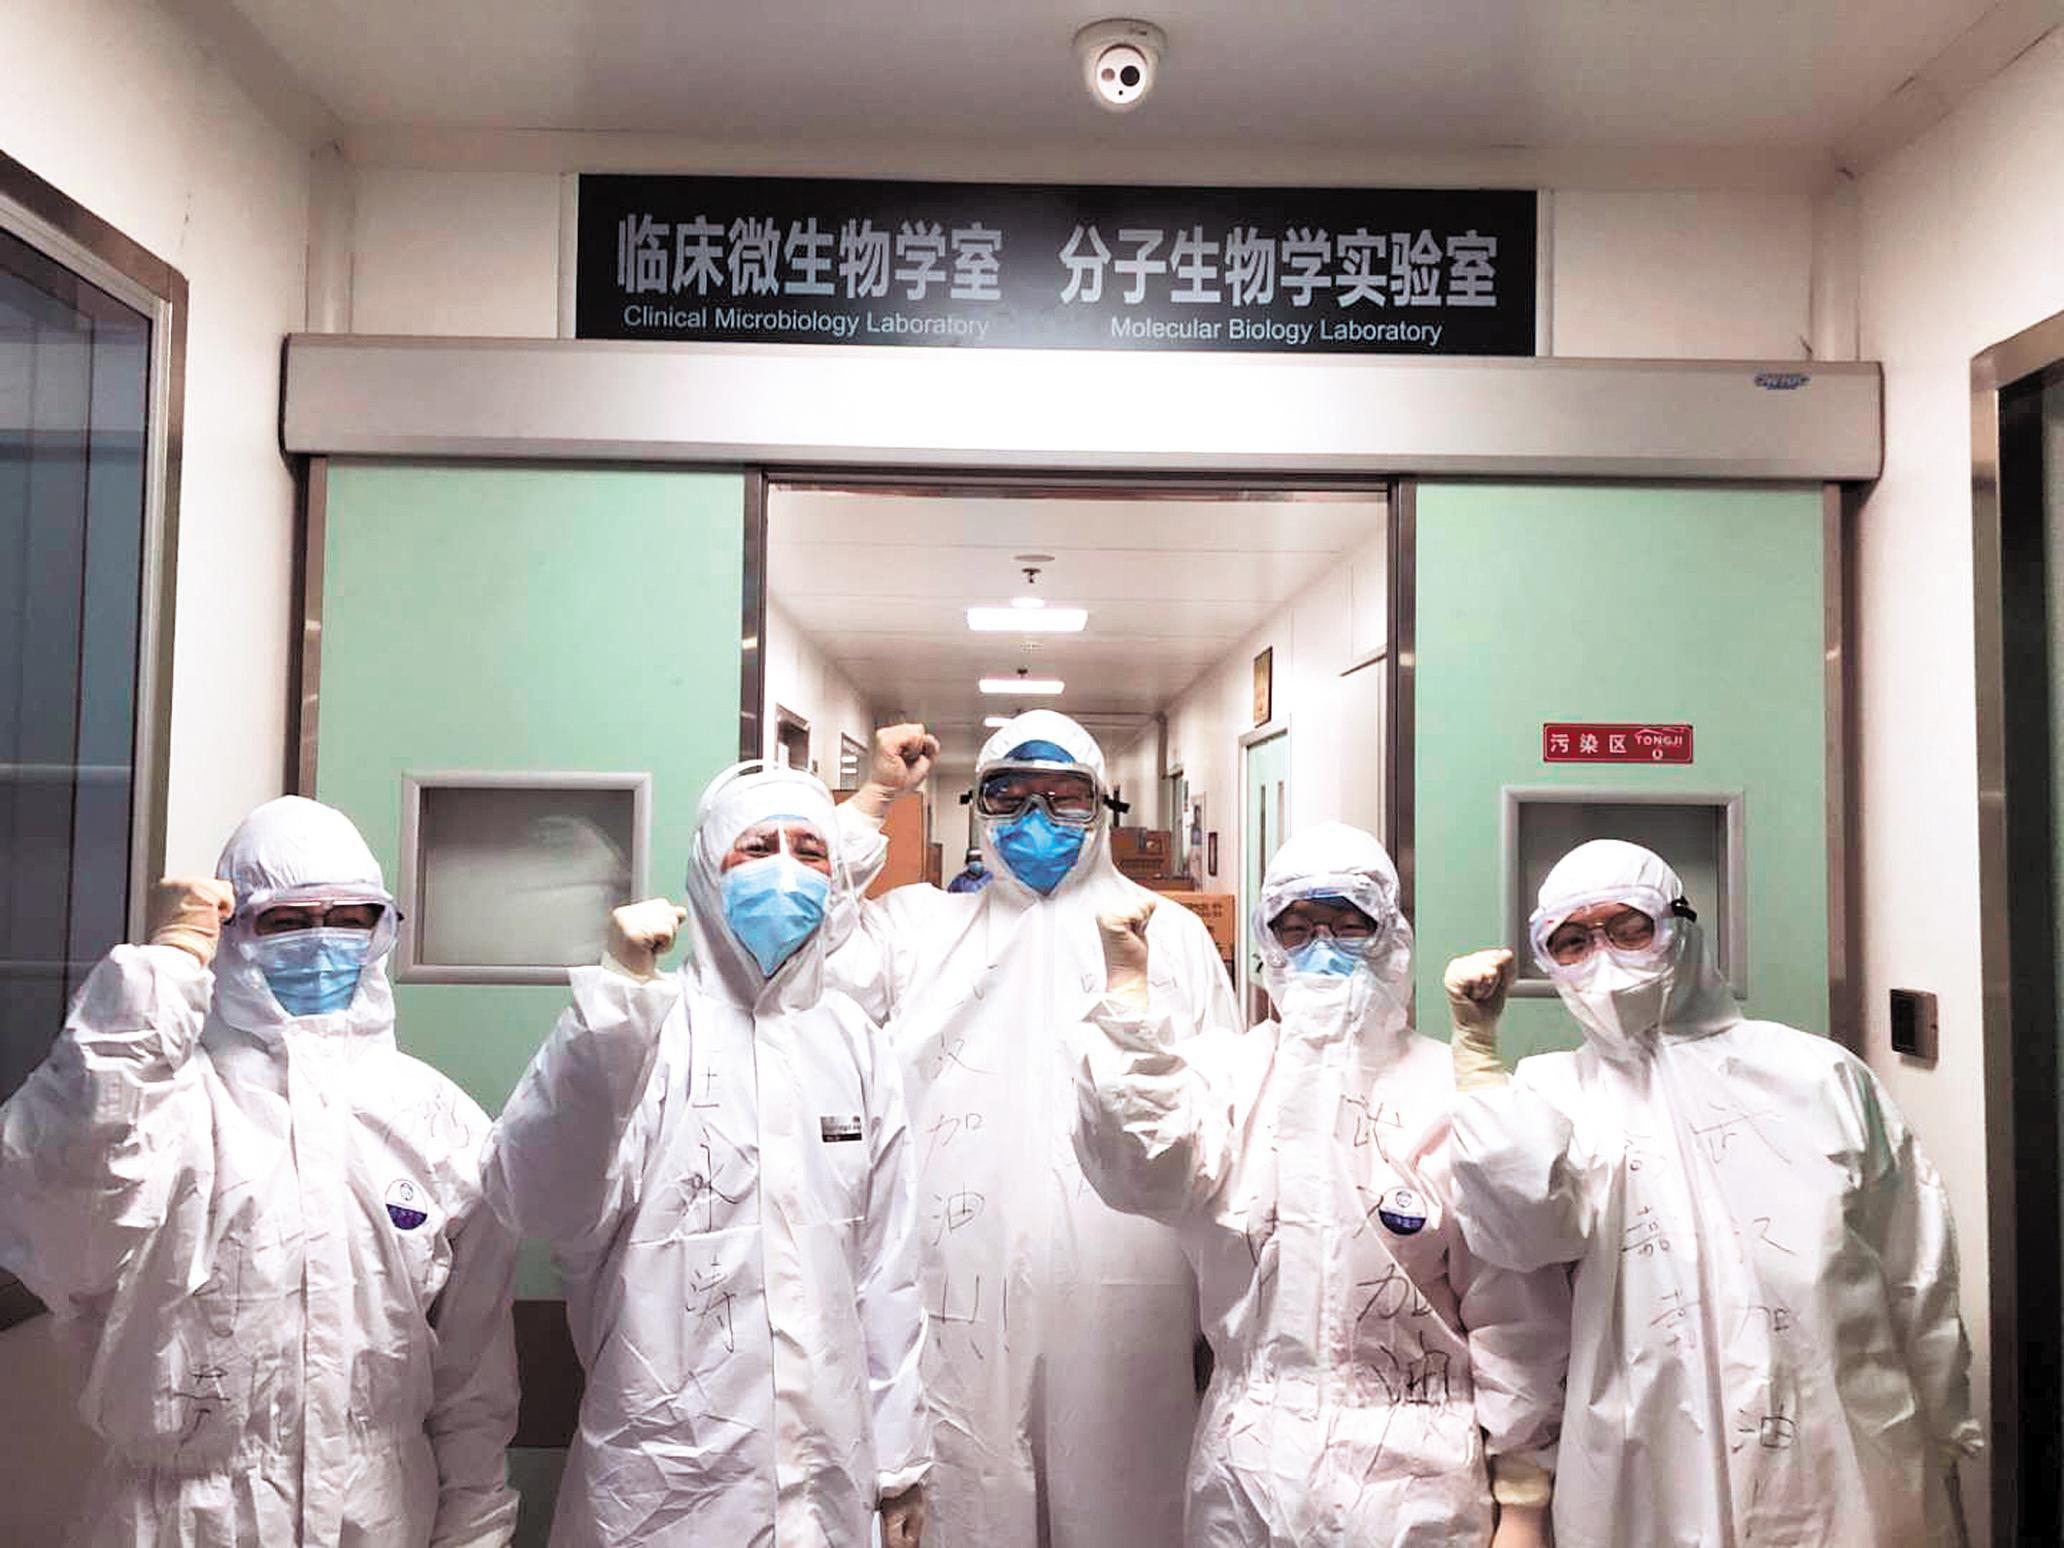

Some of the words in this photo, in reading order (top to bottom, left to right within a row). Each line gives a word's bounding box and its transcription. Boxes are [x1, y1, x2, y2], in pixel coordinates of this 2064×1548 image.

[616, 212, 1002, 300] 临床微生物学室
[1059, 224, 1498, 307] 分子生物学实验室
[623, 304, 706, 328] Clinical
[715, 307, 860, 337] Microbiology
[866, 310, 990, 339] Laboratory
[1111, 316, 1221, 340] Molecular
[1229, 317, 1313, 345] Biology
[1320, 320, 1443, 347] Laboratory
[1550, 733, 1627, 754] 污染区
[1634, 735, 1684, 748] TONGJI
